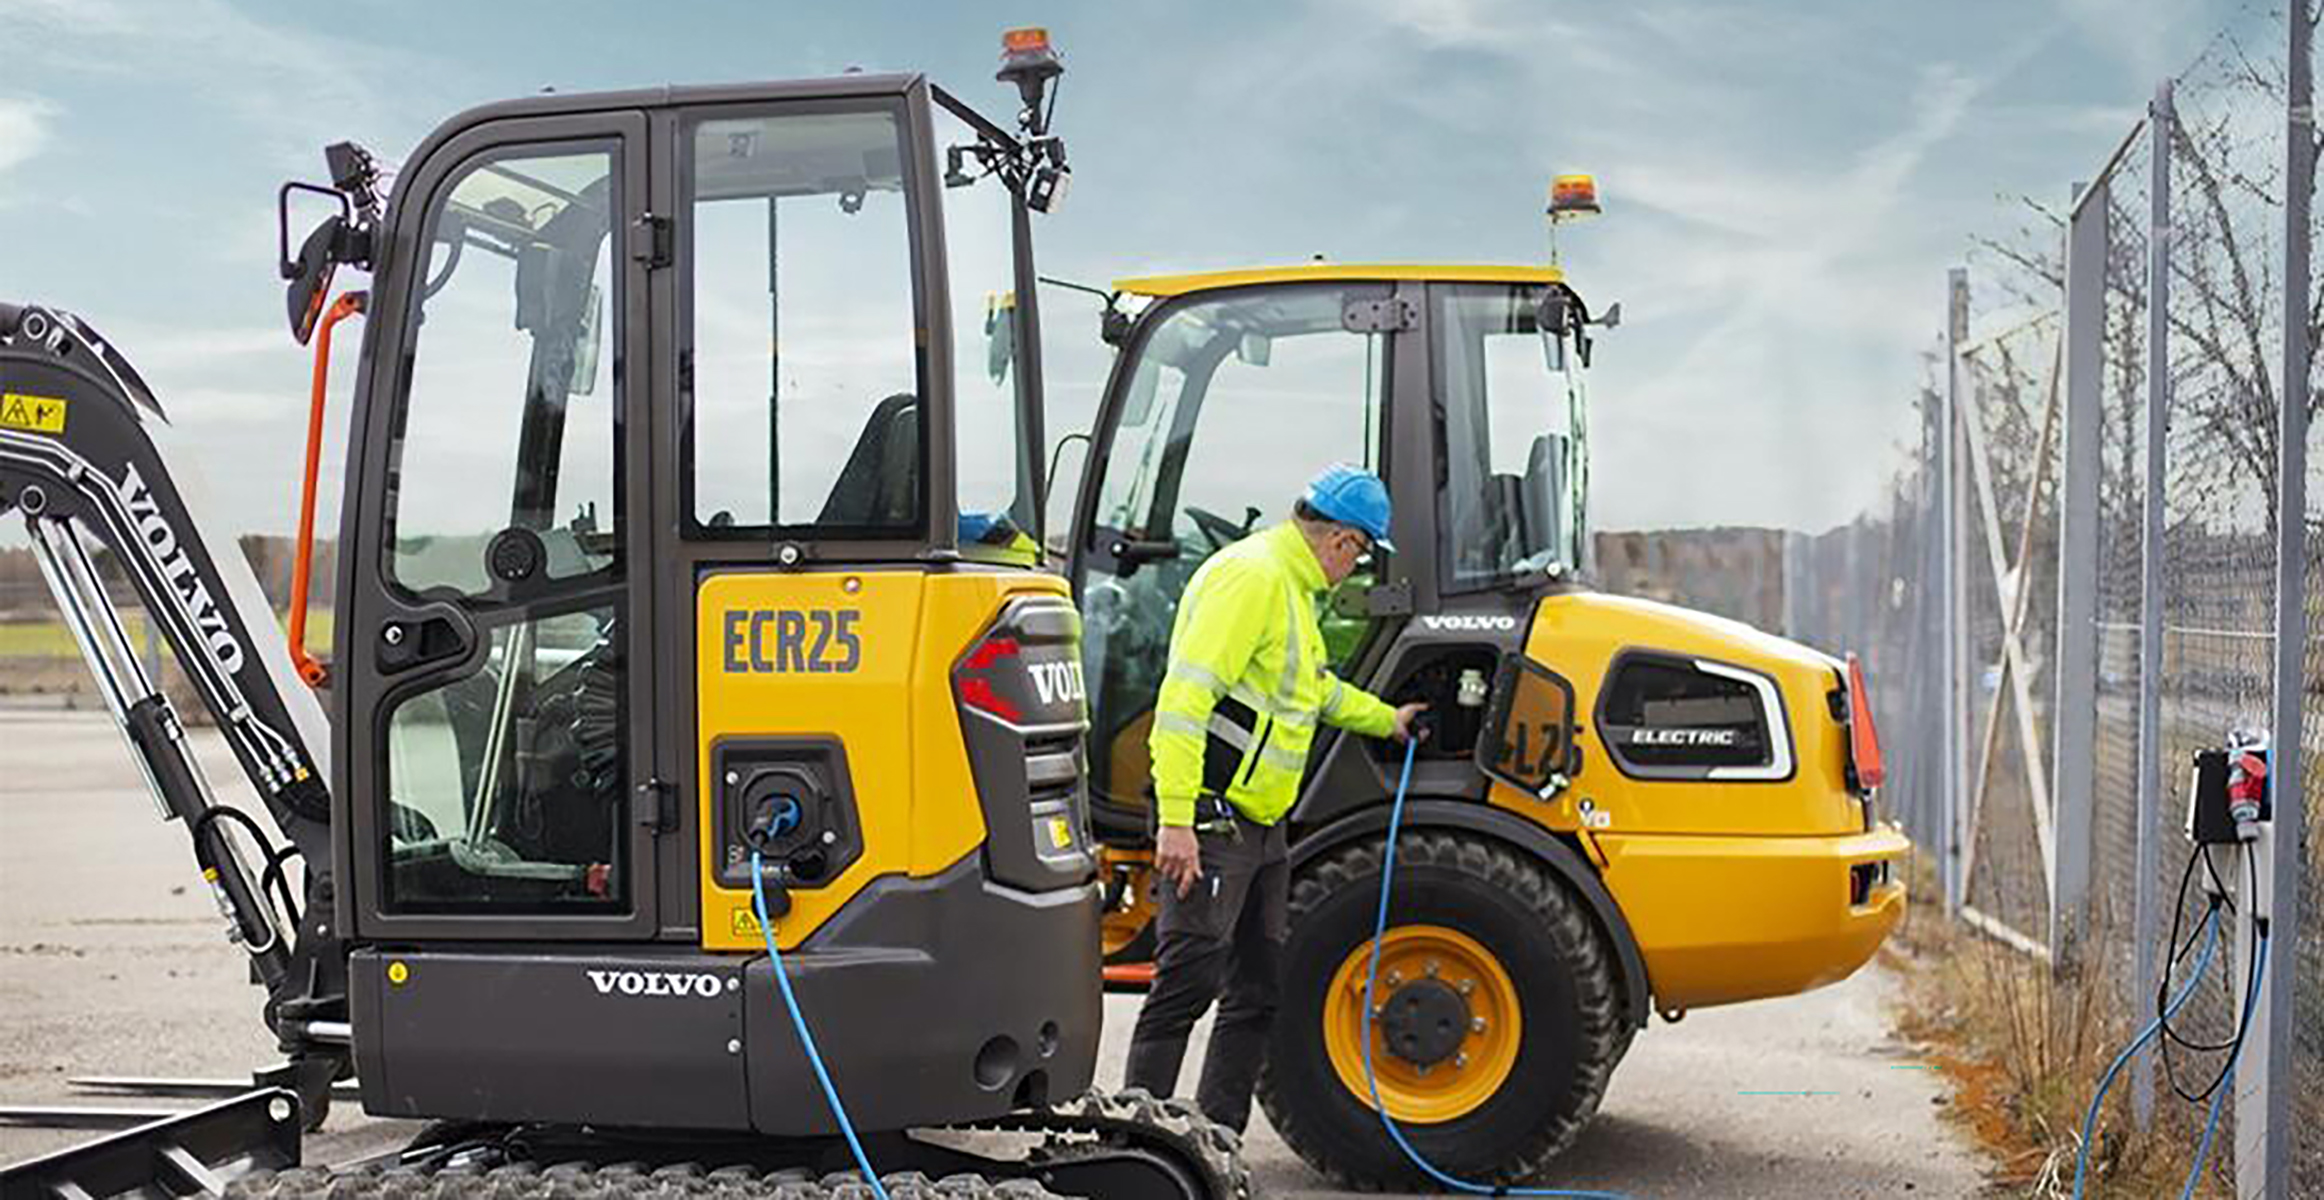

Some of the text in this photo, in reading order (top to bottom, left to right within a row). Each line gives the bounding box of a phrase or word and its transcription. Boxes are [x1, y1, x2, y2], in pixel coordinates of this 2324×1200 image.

[120, 461, 244, 674] VOLVO
[1421, 615, 1515, 630] VOLVO
[724, 610, 861, 673] ECR25
[1632, 729, 1734, 745] ELECTRIC
[586, 970, 722, 997] VOLVO
